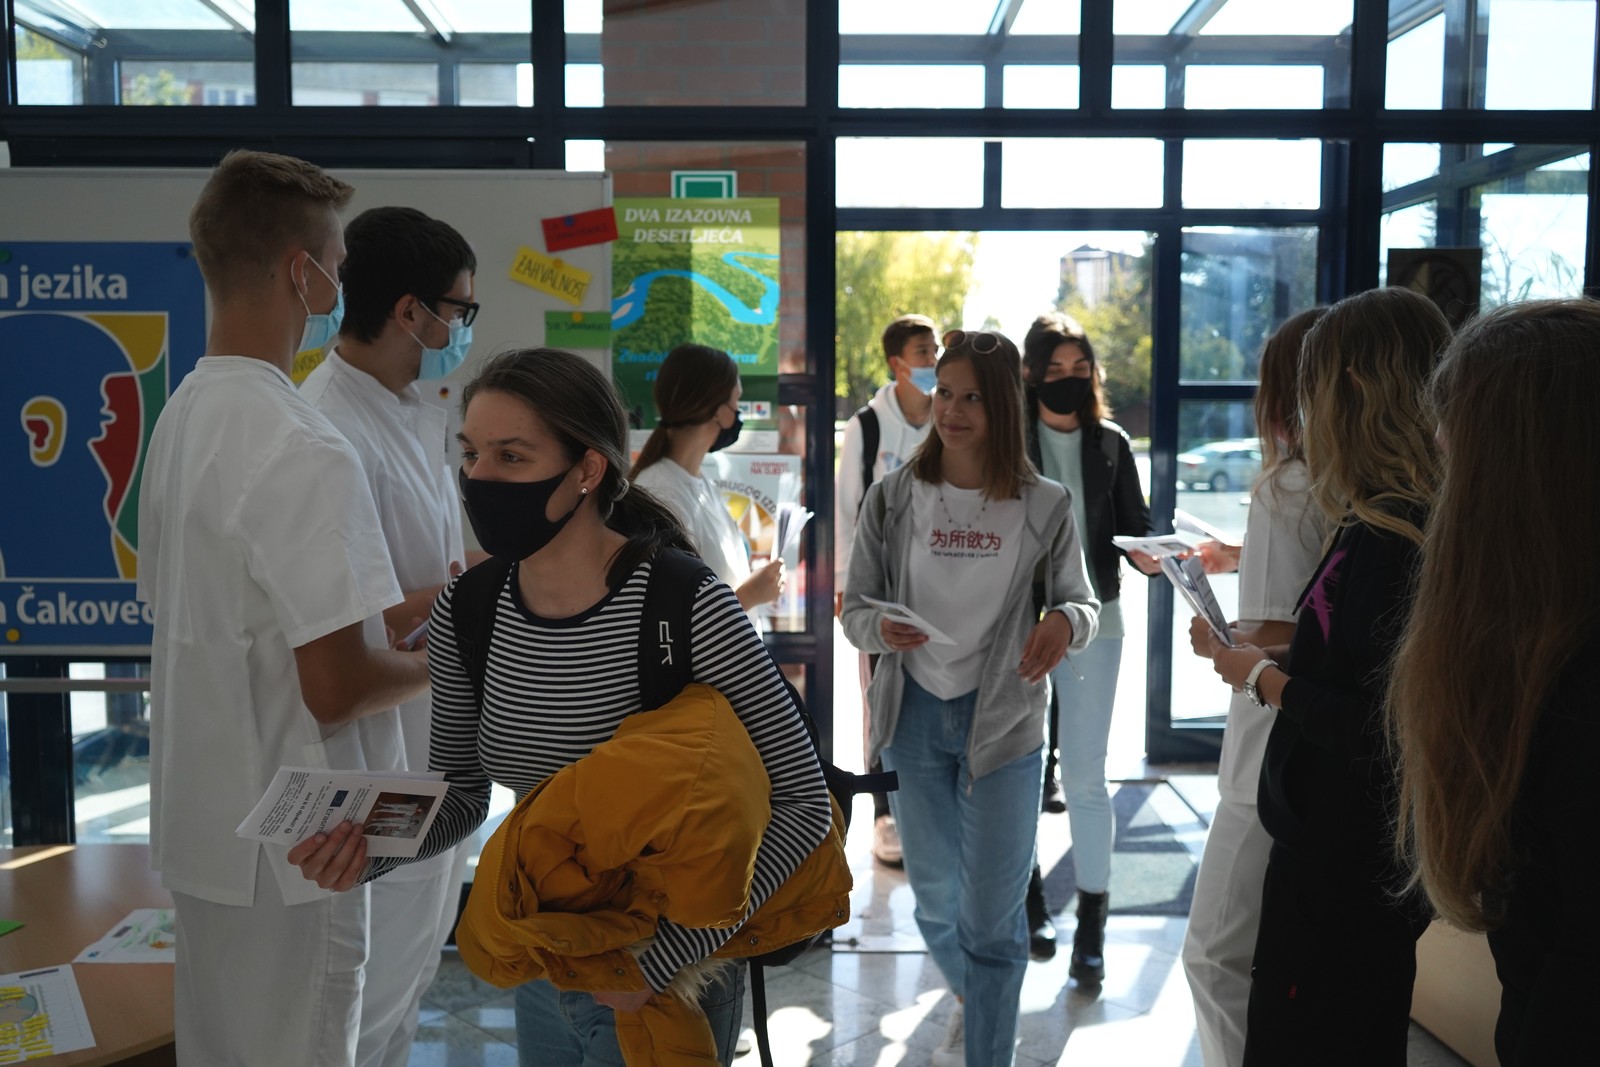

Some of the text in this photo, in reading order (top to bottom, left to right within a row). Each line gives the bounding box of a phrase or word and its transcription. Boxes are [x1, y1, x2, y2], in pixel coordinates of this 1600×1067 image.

[624, 208, 752, 223] DVA IZAZOVNA
[633, 226, 744, 243] DESETLJEĆA
[16, 264, 128, 309] jezika
[515, 254, 587, 302] ZAHVALNOST
[930, 529, 1001, 550] 为所欲为
